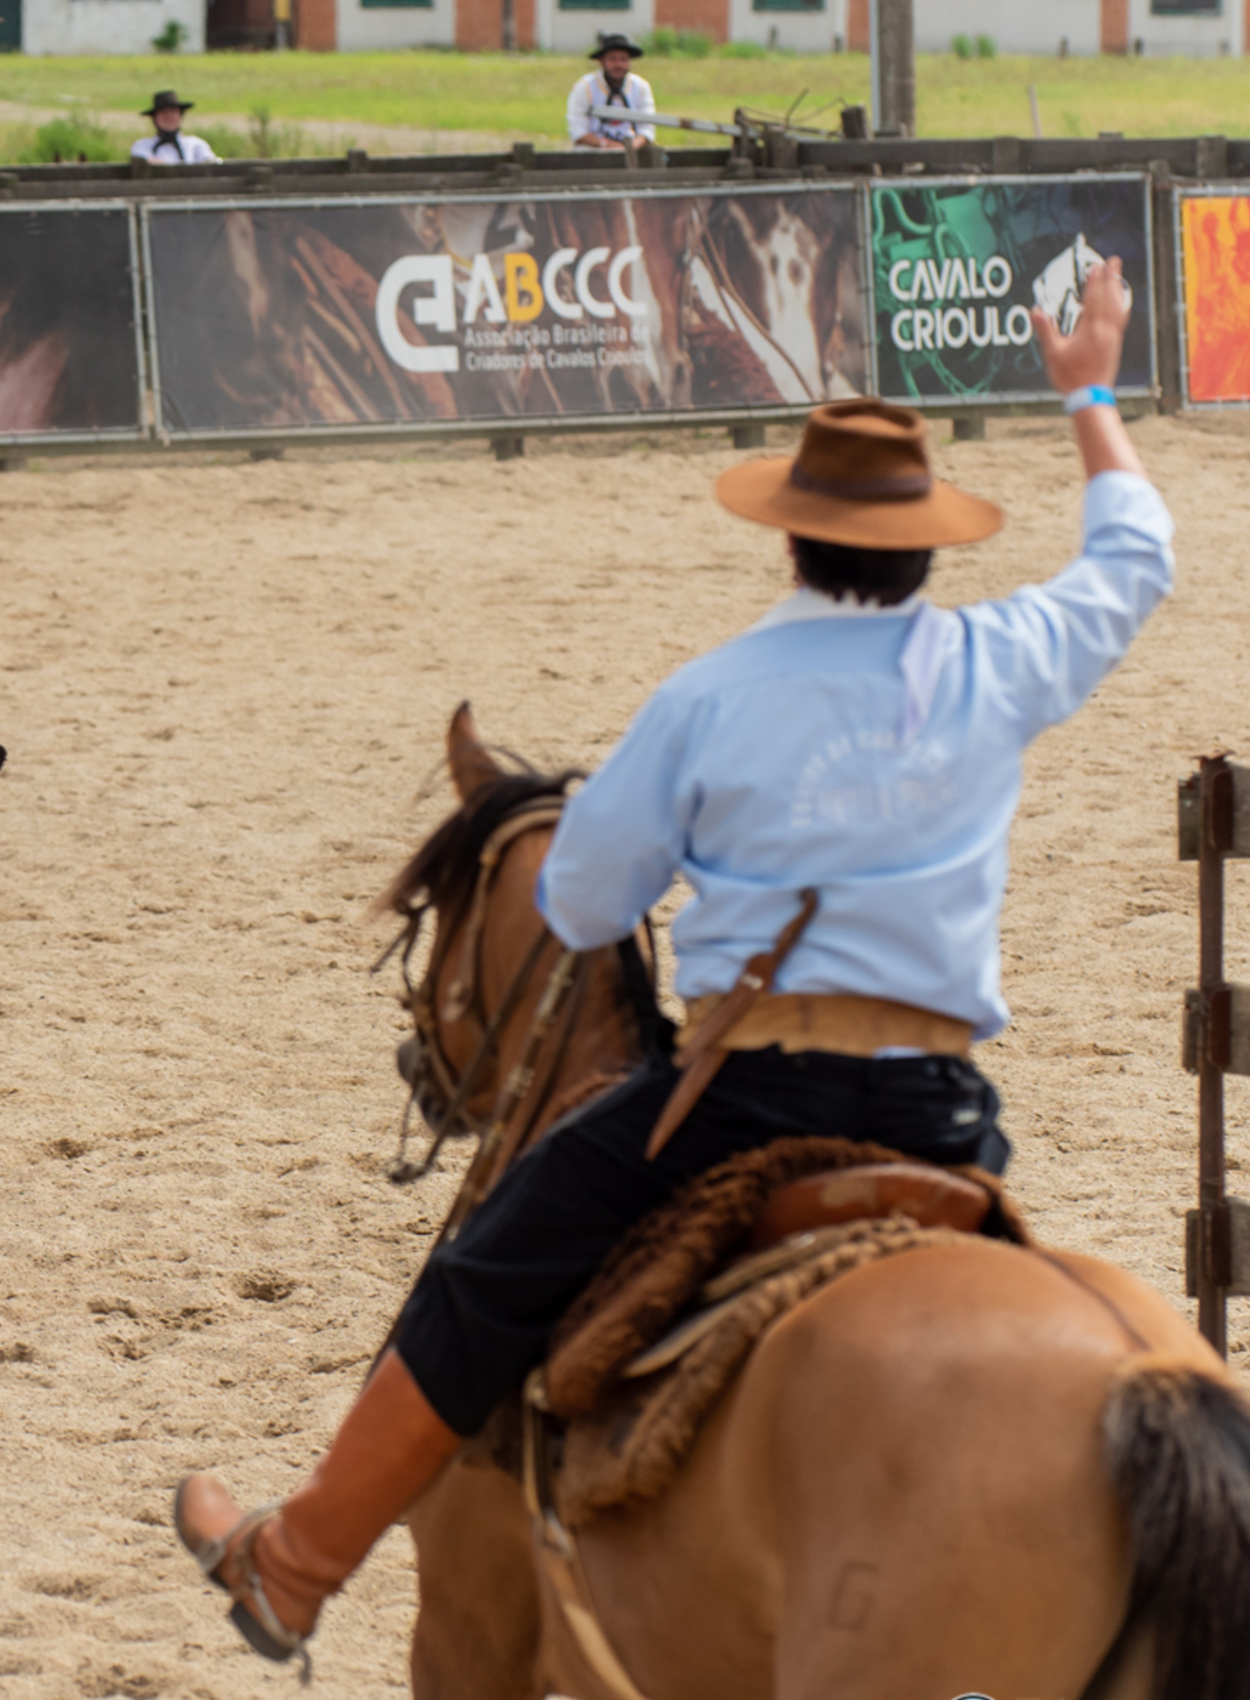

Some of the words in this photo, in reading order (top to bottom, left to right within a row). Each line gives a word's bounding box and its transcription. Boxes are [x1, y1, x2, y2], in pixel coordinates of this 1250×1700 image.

[464, 246, 648, 323] ABCCC
[888, 254, 1012, 301] CAVALO
[891, 304, 1033, 351] CRIOULO
